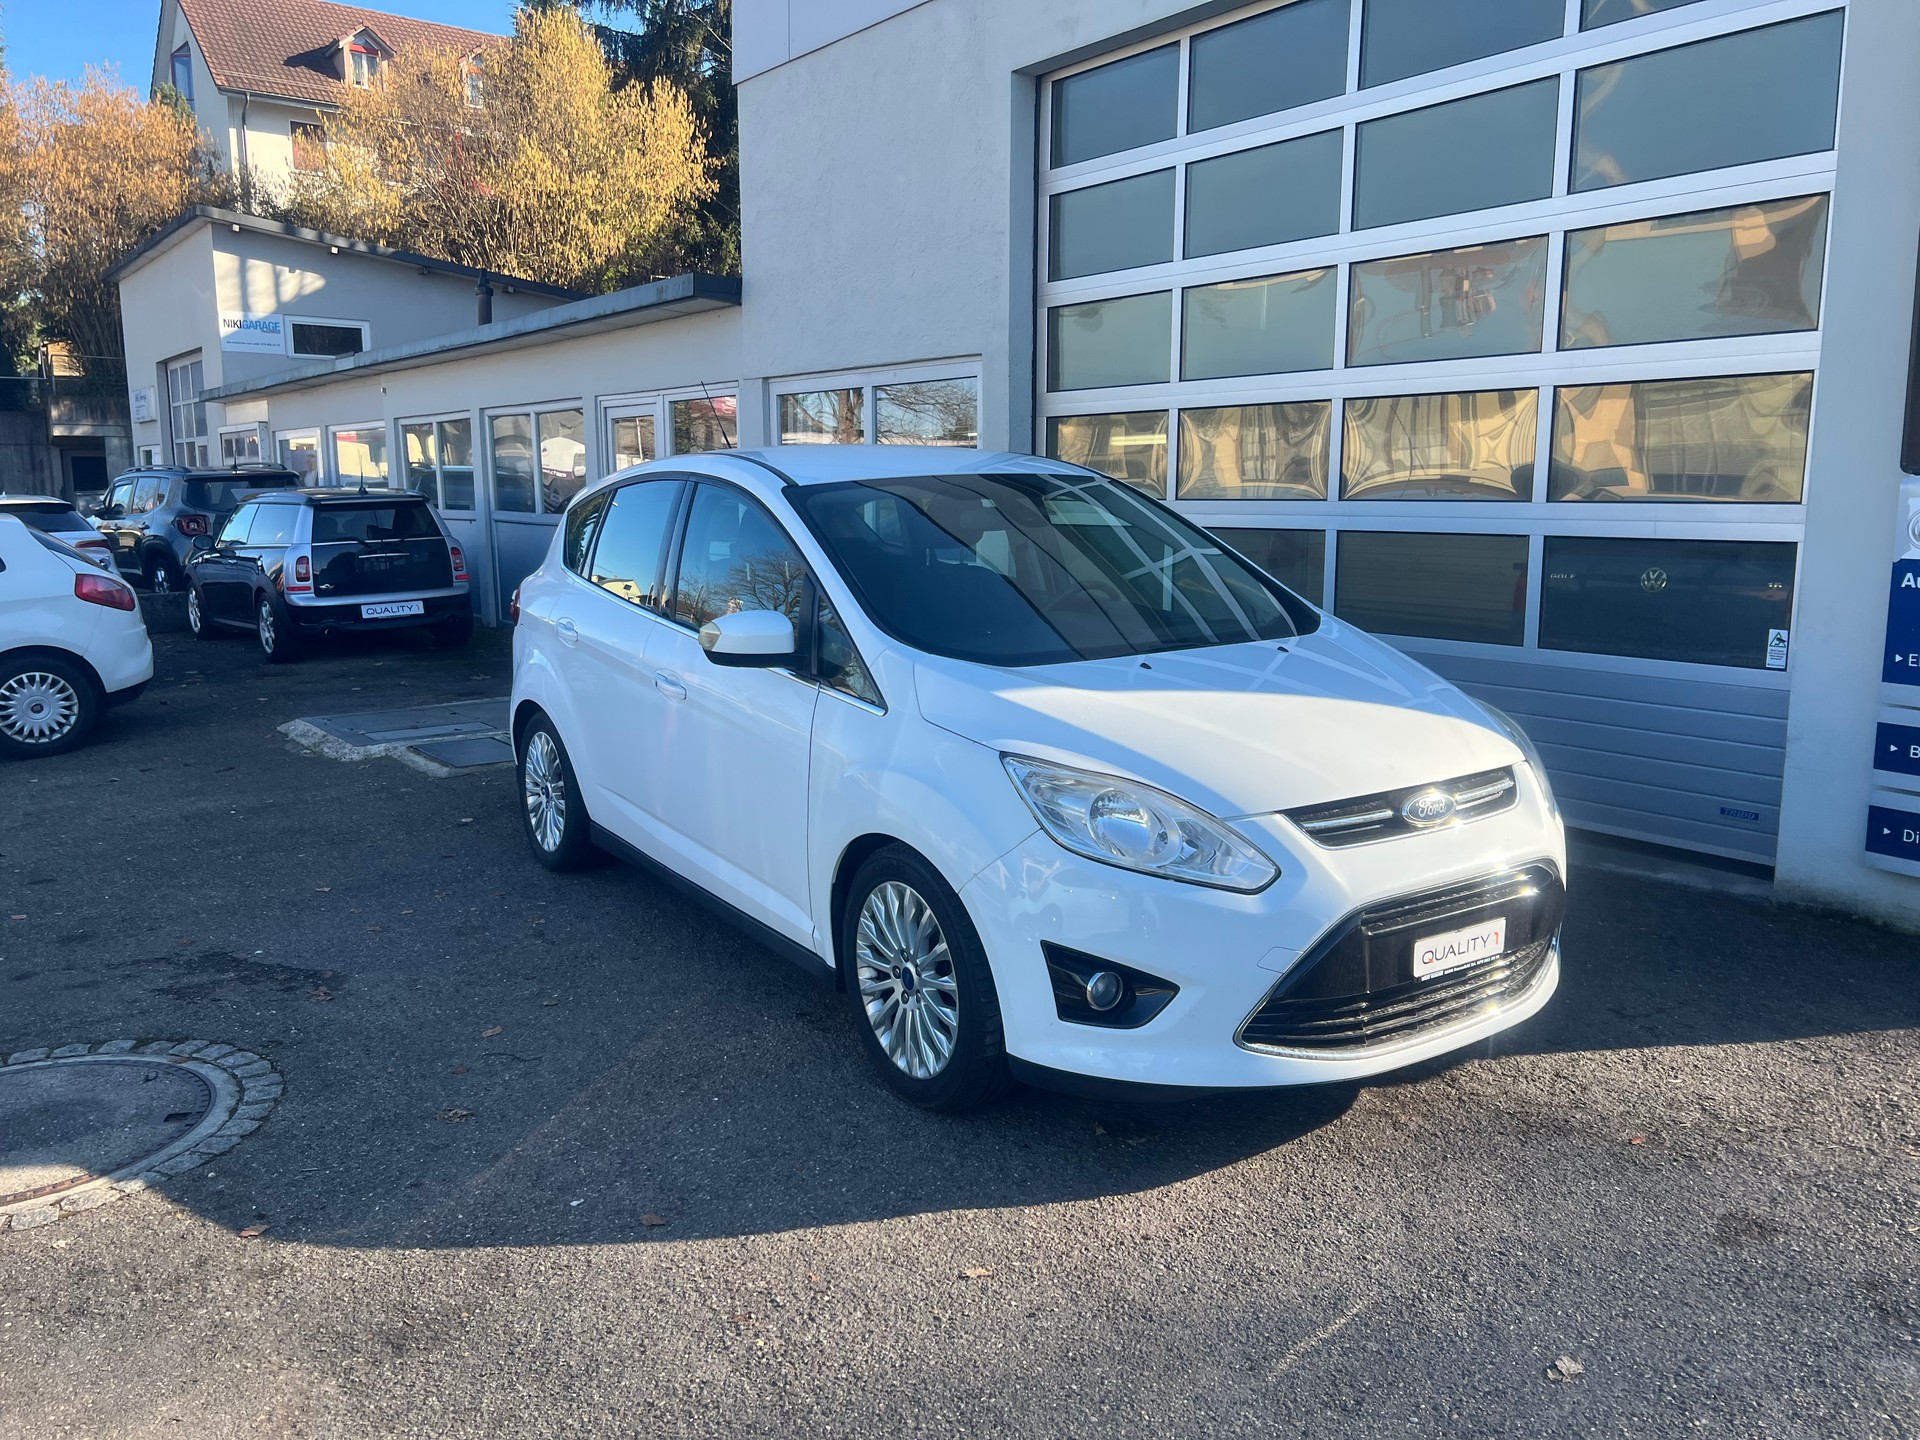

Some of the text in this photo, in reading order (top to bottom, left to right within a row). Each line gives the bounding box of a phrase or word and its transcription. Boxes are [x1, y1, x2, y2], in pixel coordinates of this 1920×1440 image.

[366, 604, 413, 615] QUALITY
[1416, 797, 1447, 818] Ford
[1421, 931, 1499, 965] QUALITY 1
